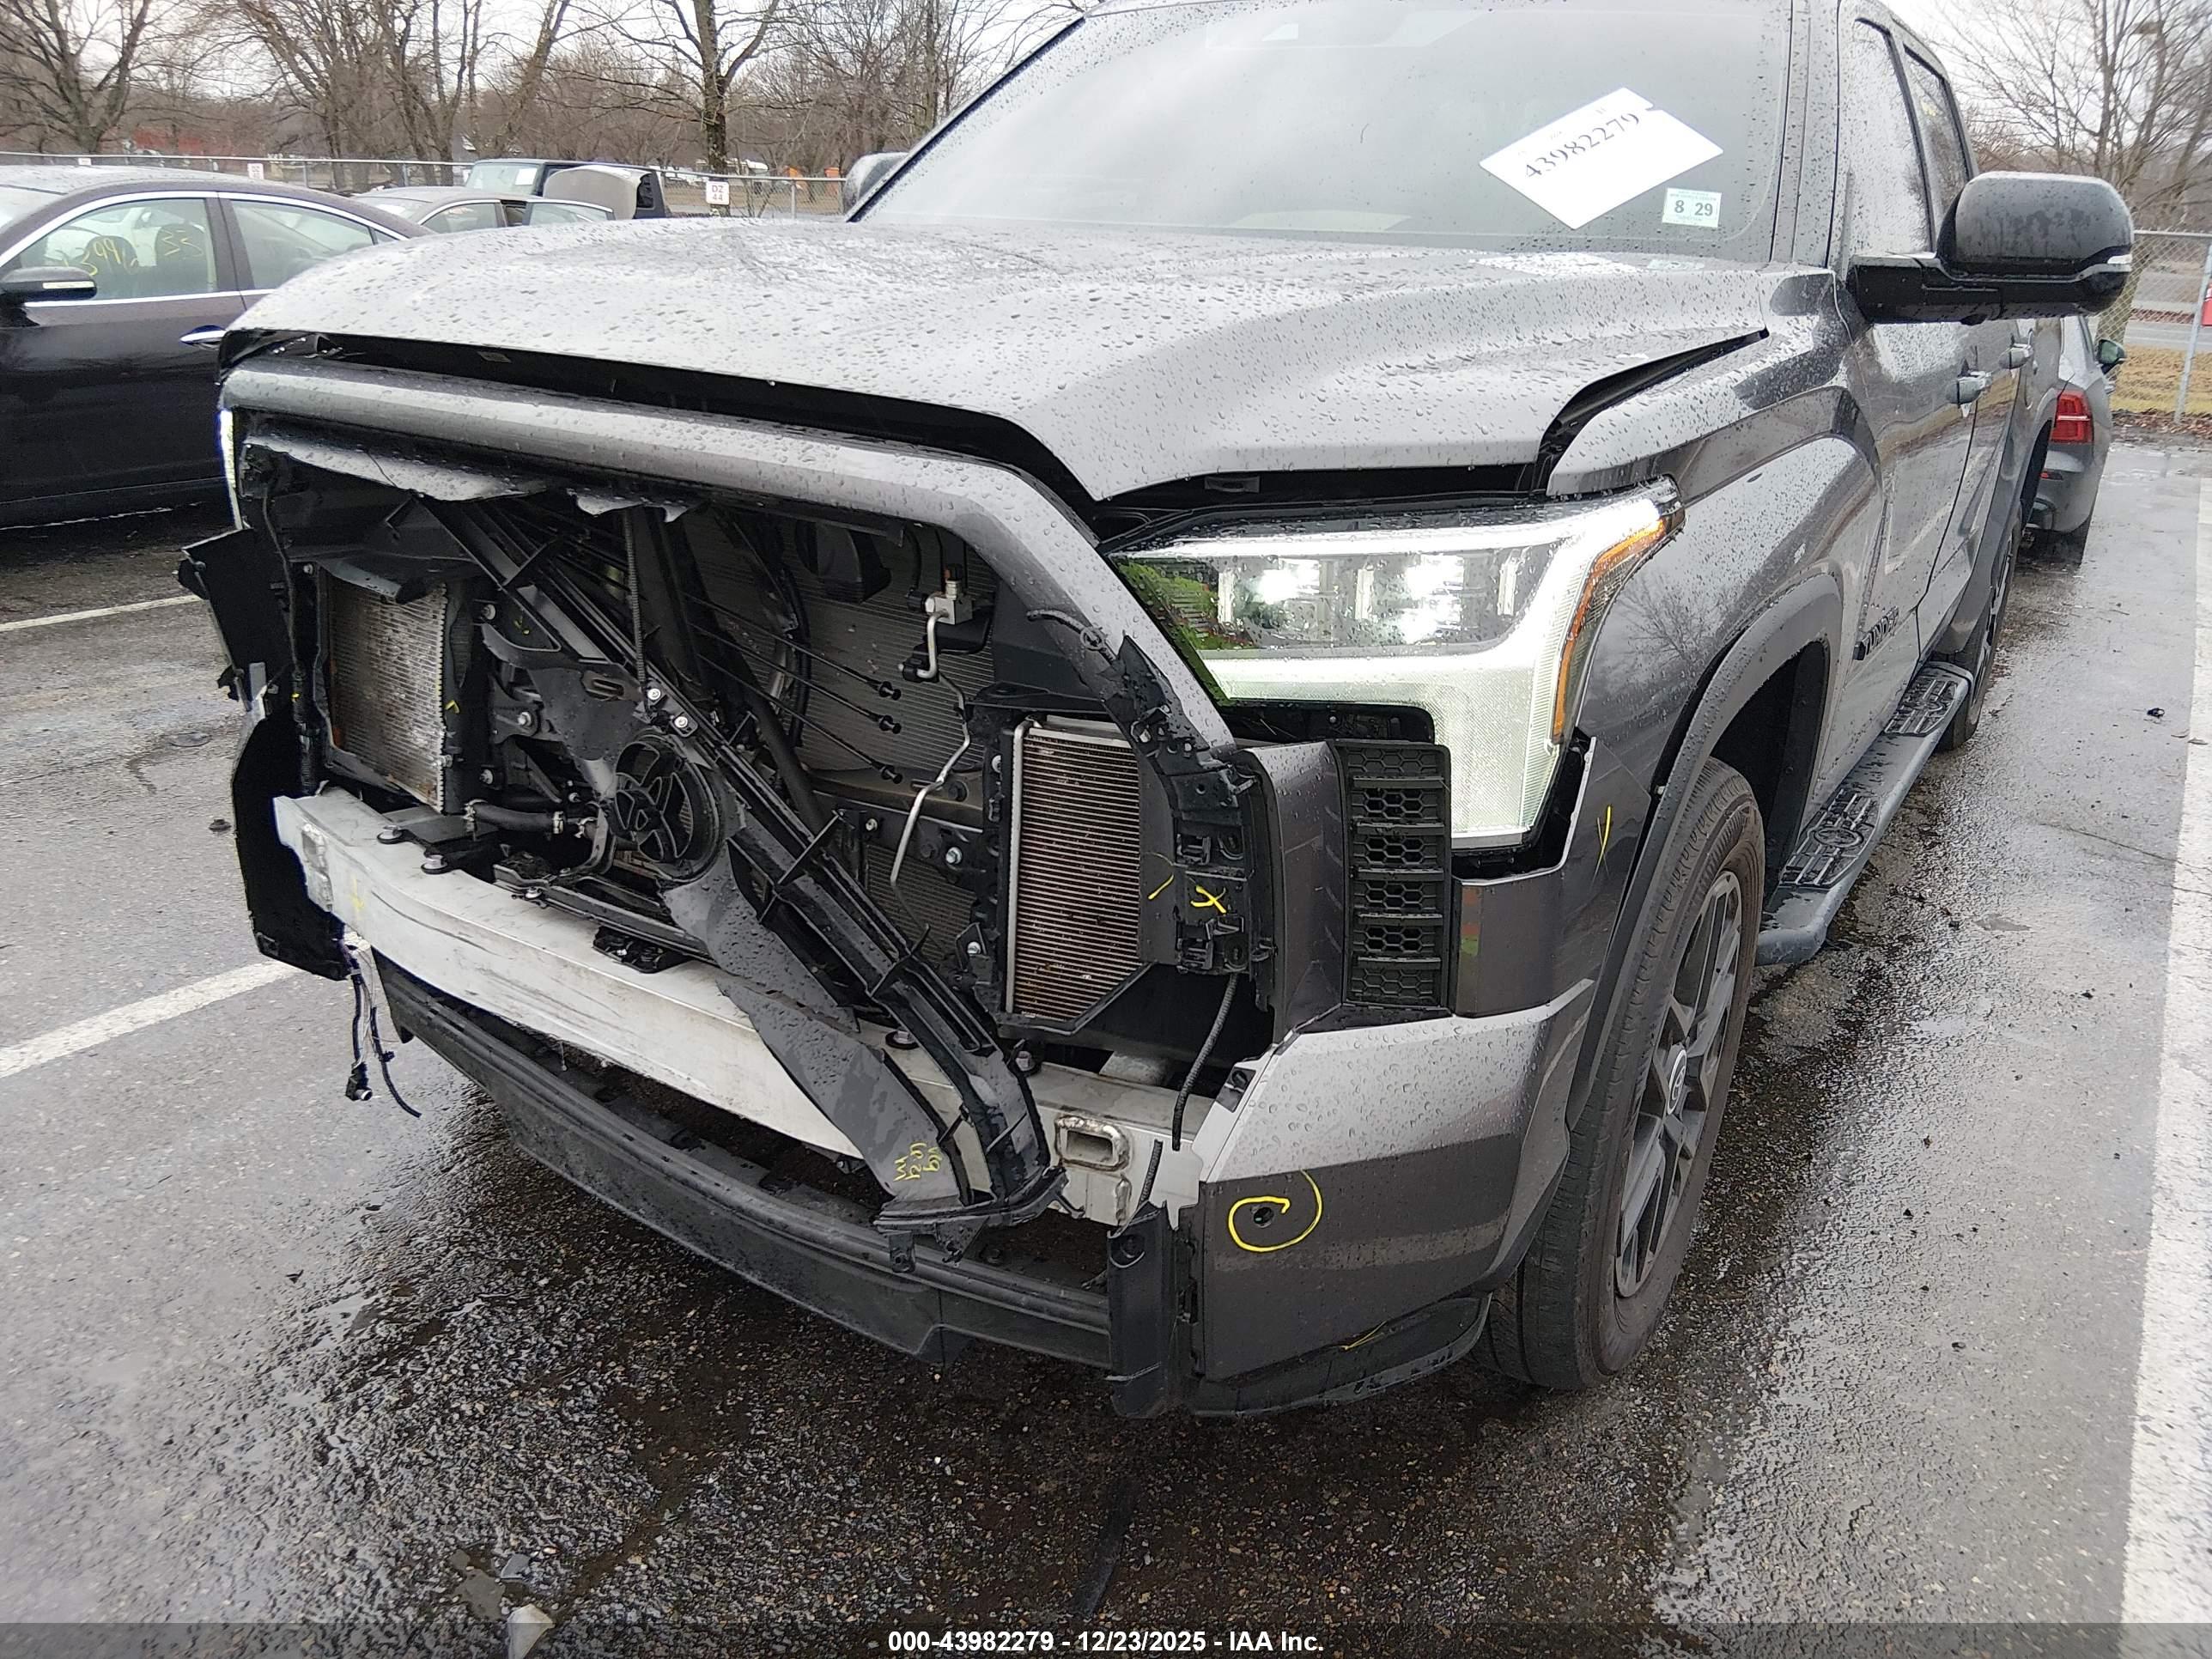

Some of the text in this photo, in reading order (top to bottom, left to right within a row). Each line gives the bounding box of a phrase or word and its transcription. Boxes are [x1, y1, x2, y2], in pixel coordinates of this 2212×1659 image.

[1524, 112, 1640, 178] 43982279
[1674, 199, 1713, 216] 8 29
